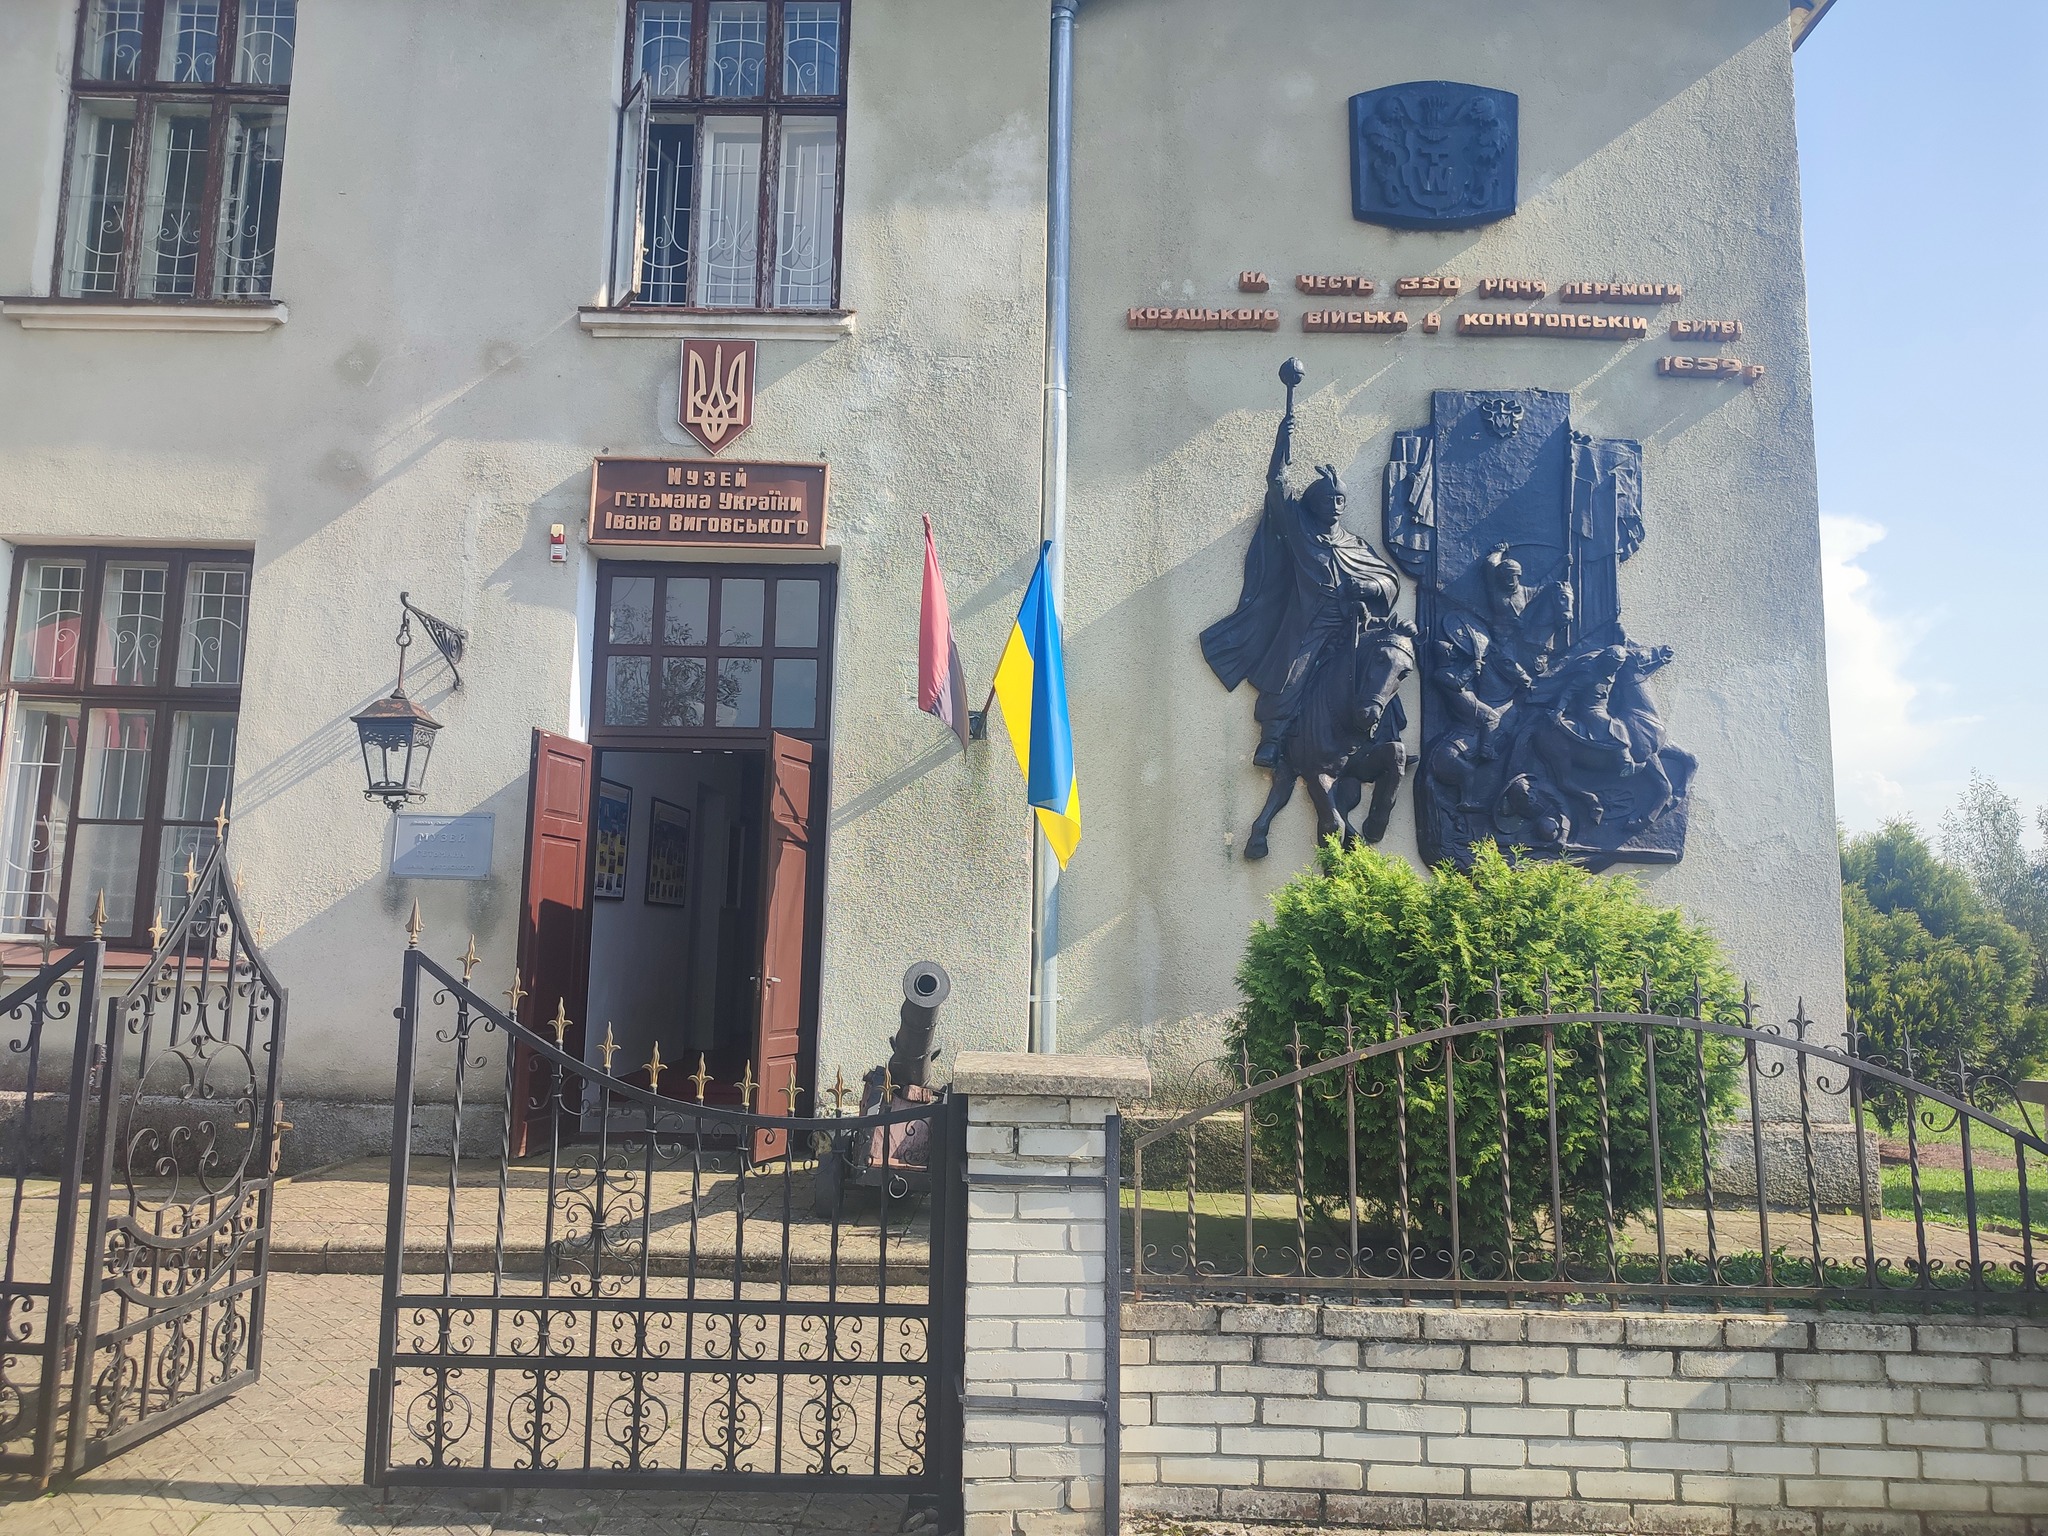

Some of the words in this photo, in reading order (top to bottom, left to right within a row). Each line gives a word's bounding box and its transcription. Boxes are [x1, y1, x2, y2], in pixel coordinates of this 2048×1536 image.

[1241, 271, 1269, 286] НА
[1298, 274, 1375, 291] ЧЕСТЬ
[1399, 276, 1462, 291] 350
[1483, 278, 1547, 294] РІЧЧЯ
[1563, 282, 1682, 298] ПЕРЕМОГИ
[1129, 308, 1279, 323] КОЗАЦЬКОГО
[1305, 309, 1408, 326] ВІЙСЬКА
[1427, 312, 1440, 327] В
[1462, 312, 1648, 331] КОНОТОПСЬКІЙ
[1676, 319, 1743, 336] БИТВІ
[1662, 355, 1742, 373] 1659
[719, 490, 802, 511] України
[605, 511, 661, 530] Івана
[669, 514, 809, 535] Виговського
